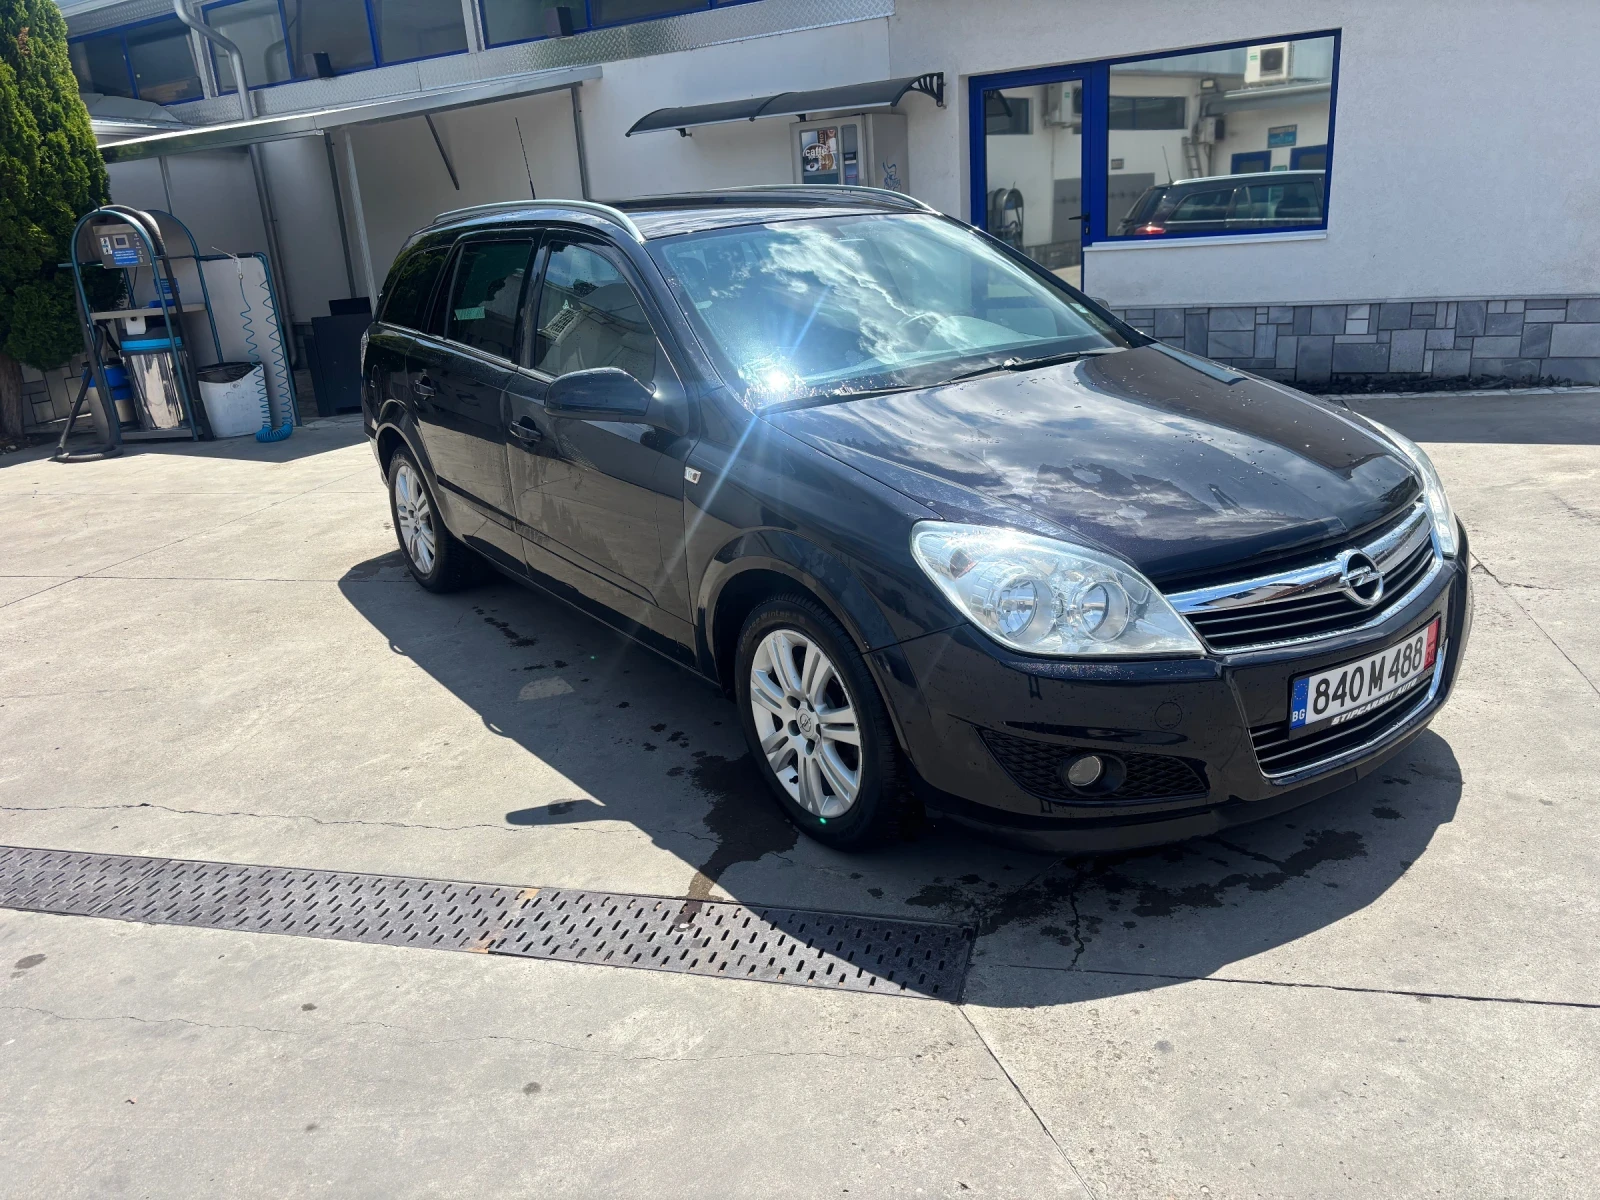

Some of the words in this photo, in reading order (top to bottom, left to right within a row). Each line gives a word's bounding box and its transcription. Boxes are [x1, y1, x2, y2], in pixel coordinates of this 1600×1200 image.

[1312, 666, 1365, 715] 840
[1367, 655, 1386, 697] M
[1388, 636, 1424, 683] 488
[1292, 708, 1306, 722] BG
[1331, 692, 1394, 725] STIPCARSKI
[1395, 677, 1418, 696] AUTO
